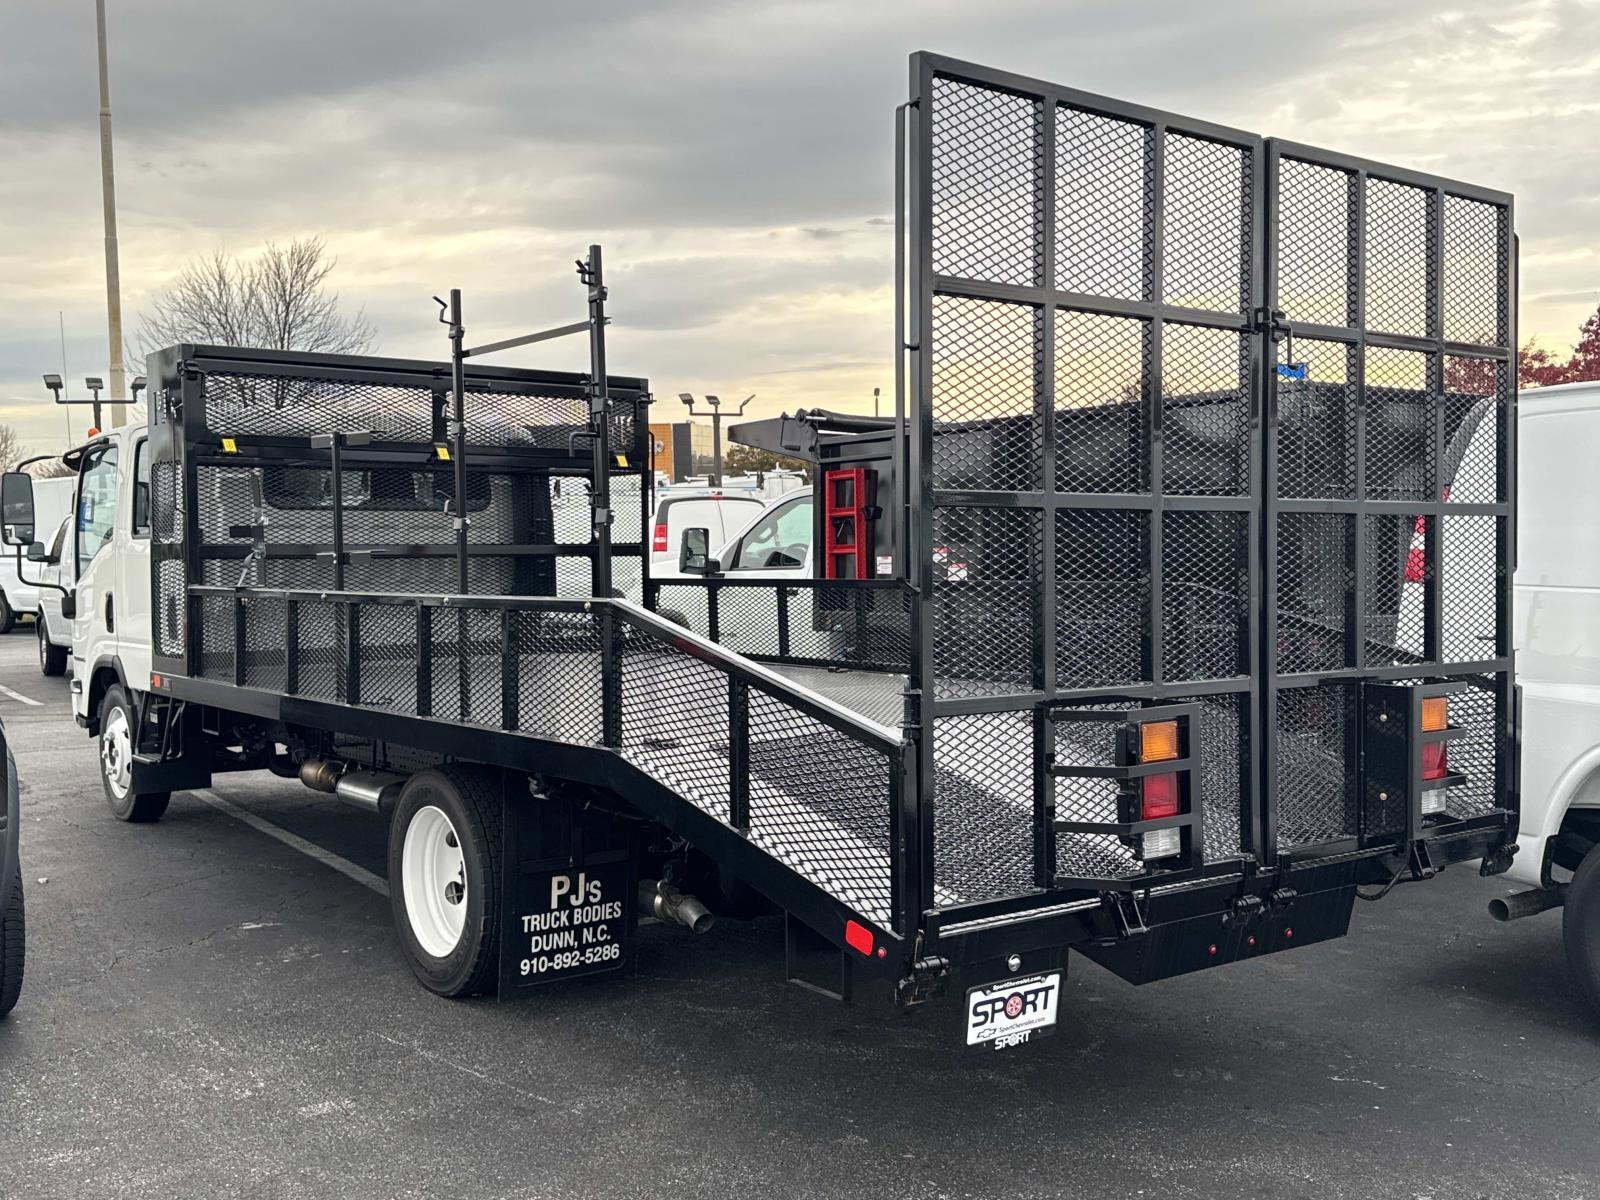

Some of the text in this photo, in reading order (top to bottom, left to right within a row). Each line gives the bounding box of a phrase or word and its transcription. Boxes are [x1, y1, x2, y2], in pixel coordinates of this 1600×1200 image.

[552, 873, 602, 909] PJ's
[522, 901, 622, 933] TRUCK BODIES
[531, 924, 611, 953] DUNN, N.C.
[520, 943, 620, 976] 910-892-5286
[972, 985, 1055, 1028] SPORT
[994, 1030, 1032, 1050] SPORT
